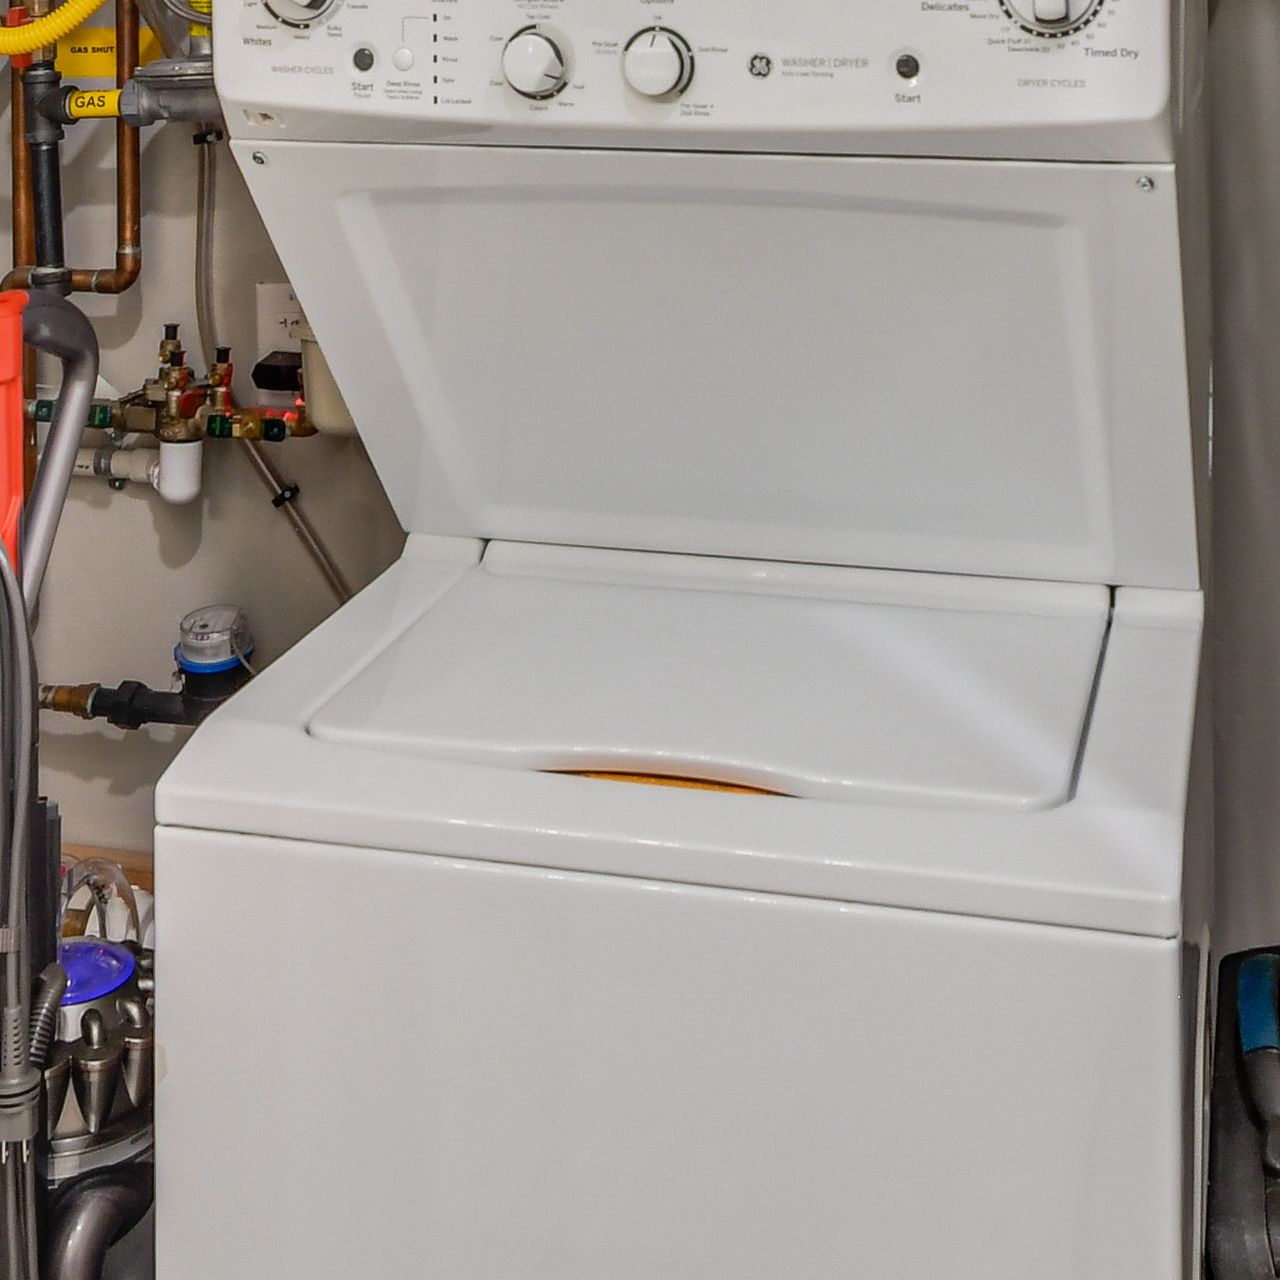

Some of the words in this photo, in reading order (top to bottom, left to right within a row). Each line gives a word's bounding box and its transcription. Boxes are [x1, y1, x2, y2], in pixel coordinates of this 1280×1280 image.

[921, 1, 969, 12] Delicates
[242, 37, 273, 47] Whites
[70, 46, 89, 54] GAS
[91, 46, 115, 54] SHUT
[1084, 47, 1118, 58] Timed
[1120, 47, 1139, 60] Dry
[351, 81, 374, 91] Start
[1017, 78, 1050, 88] DRYER
[1051, 78, 1087, 88] CYCLES
[74, 95, 106, 109] GAS
[894, 93, 922, 104] Start
